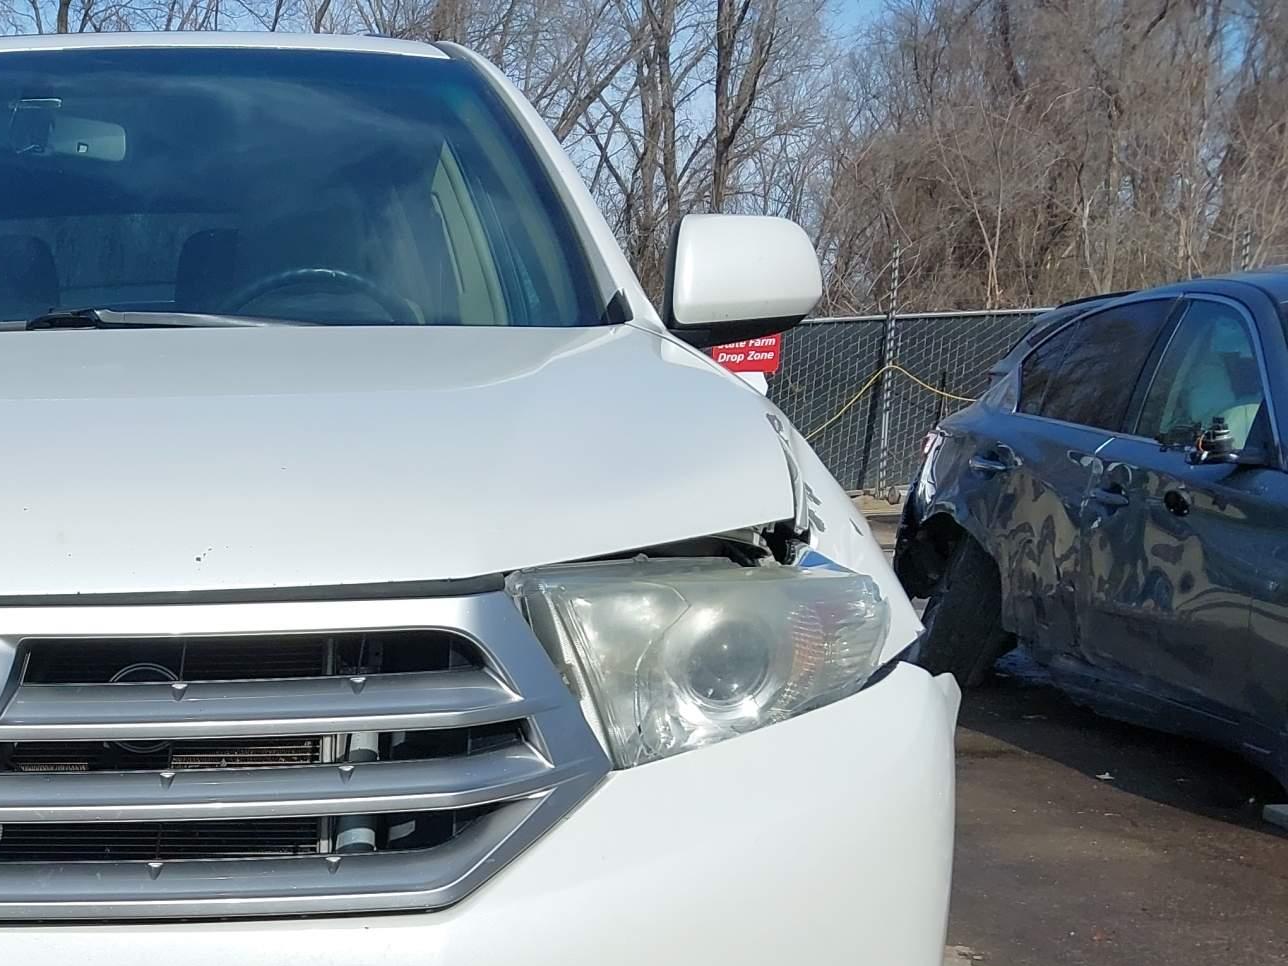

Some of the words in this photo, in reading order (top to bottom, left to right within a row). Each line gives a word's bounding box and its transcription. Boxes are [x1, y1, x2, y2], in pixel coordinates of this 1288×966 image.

[748, 337, 776, 347] Farm
[718, 352, 745, 363] Drop
[747, 351, 775, 361] Zone
